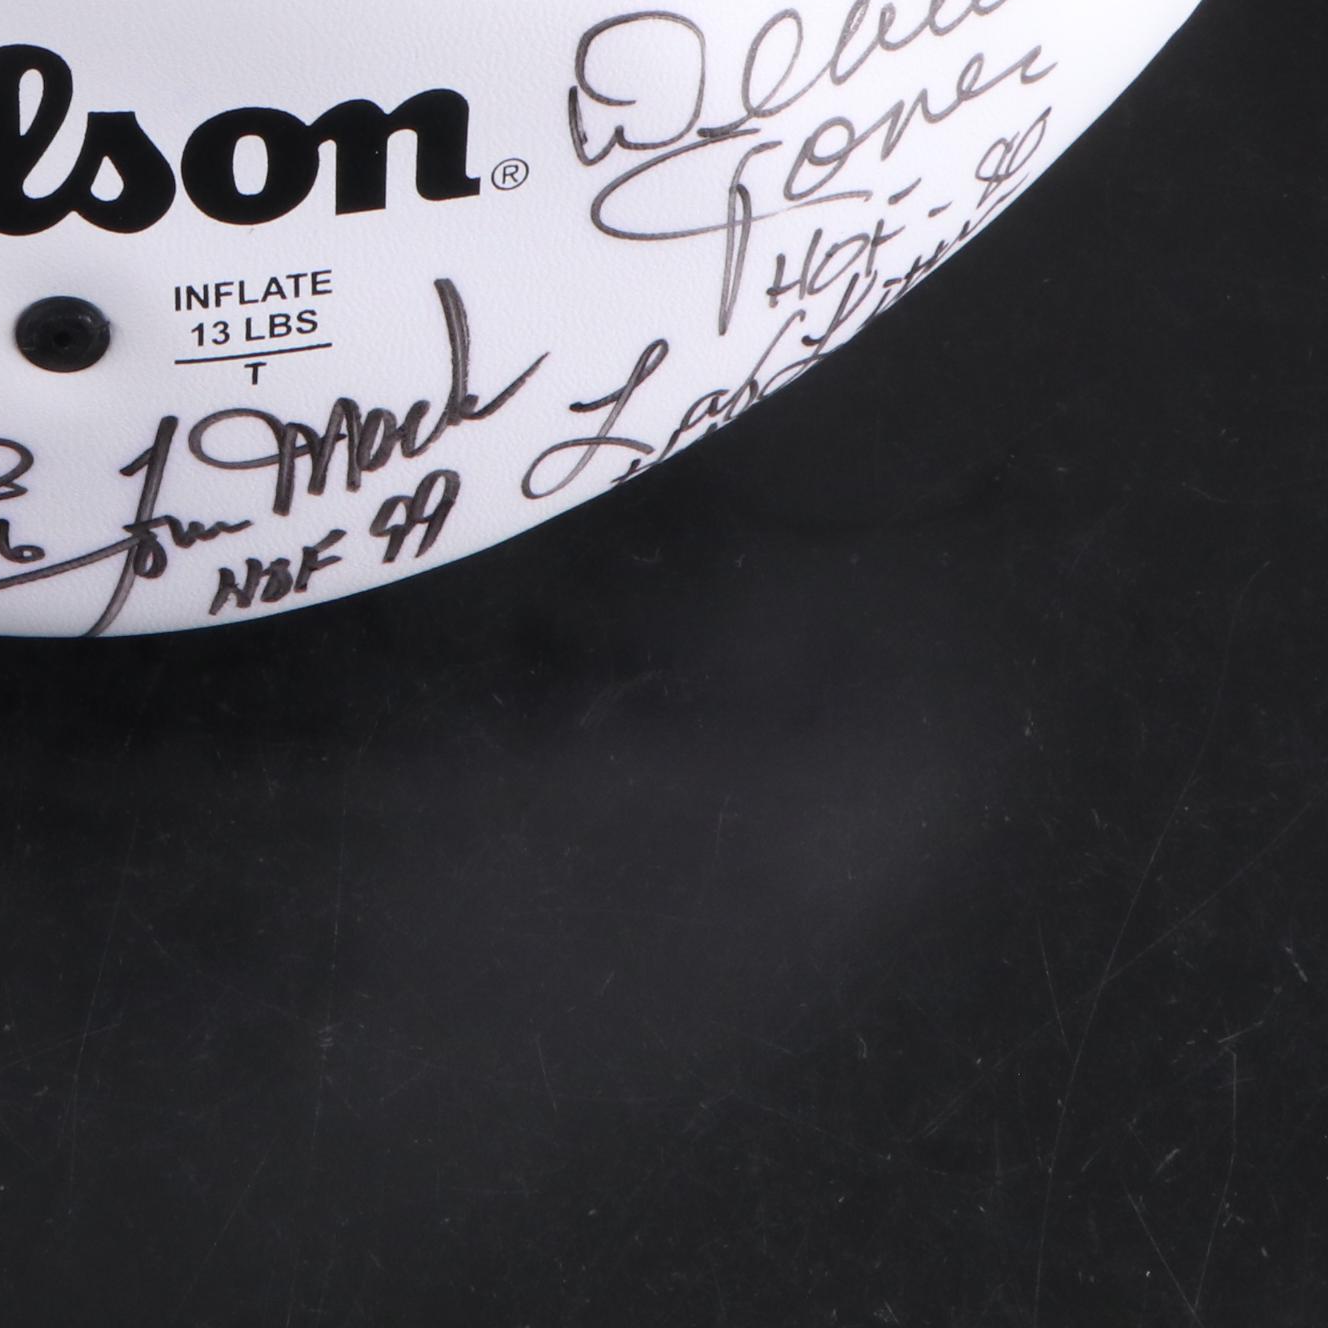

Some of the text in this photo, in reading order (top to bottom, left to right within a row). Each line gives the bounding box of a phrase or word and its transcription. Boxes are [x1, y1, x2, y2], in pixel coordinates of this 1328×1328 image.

[172, 269, 335, 313] INFLATE
[190, 308, 320, 349] 13 LBS
[244, 361, 267, 387] T
